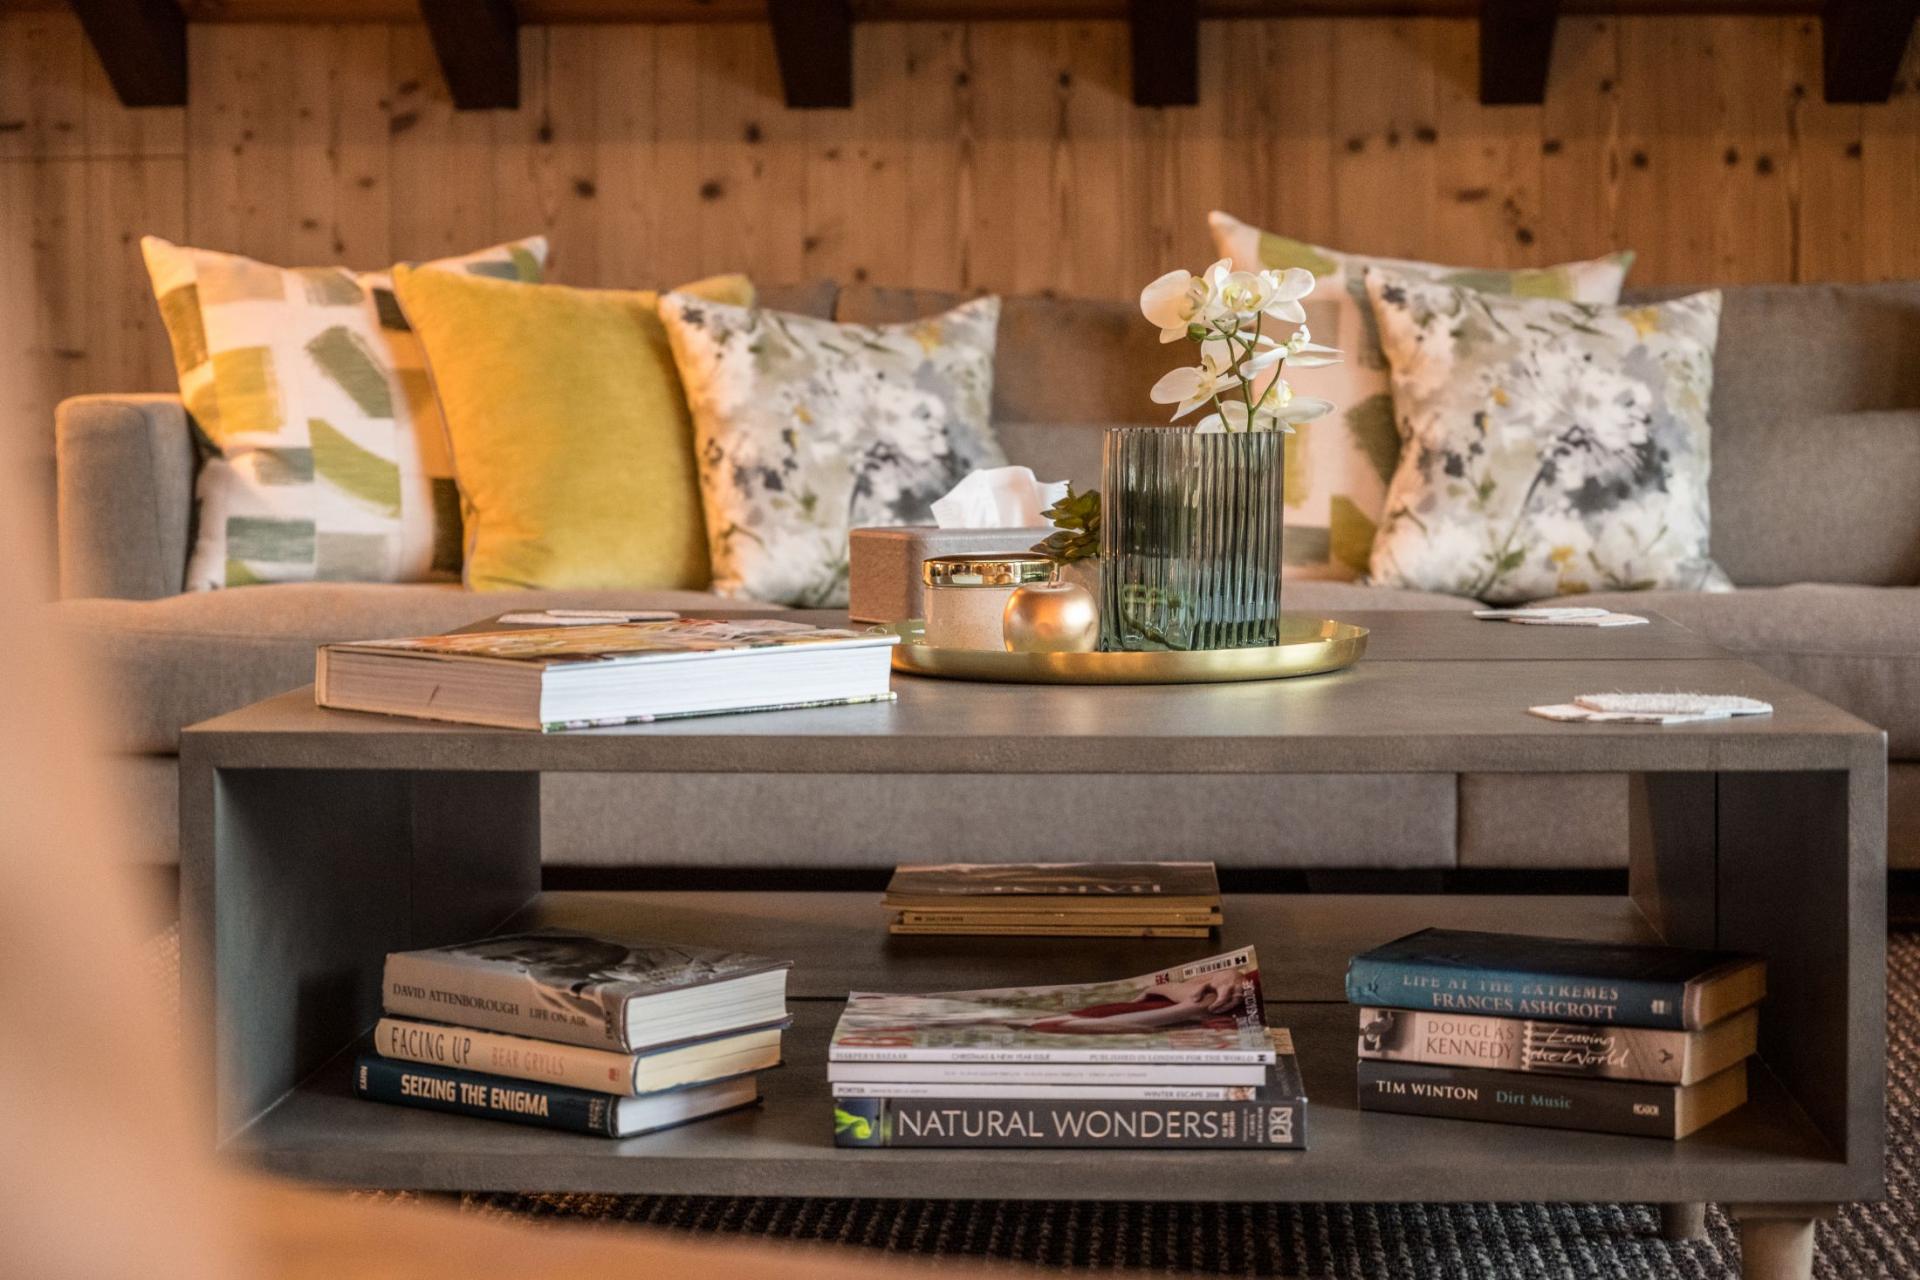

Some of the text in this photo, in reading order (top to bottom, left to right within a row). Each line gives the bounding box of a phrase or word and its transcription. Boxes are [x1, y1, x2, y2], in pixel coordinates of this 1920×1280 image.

[393, 984, 520, 1015] DAVID ATTENBOROUGH
[1403, 974, 1619, 1001] LIFE AT THE EXTREMES
[529, 1007, 589, 1027] LIFE ON AIR
[1432, 992, 1617, 1020] FRANCES ASHCROFT
[1427, 1020, 1515, 1041] DOUGLAS
[1546, 1031, 1616, 1052] Leaving
[391, 1026, 472, 1065] FACING UP
[1426, 1038, 1513, 1060] KENNEDY
[491, 1047, 566, 1077] BEAR GRYLLS
[1555, 1050, 1629, 1069] World
[401, 1074, 549, 1117] SEIZING THE ENIGMA
[1376, 1080, 1479, 1101] TIM WINTON
[1496, 1090, 1572, 1109] Dirt Music
[898, 1110, 1044, 1138] NATURAL
[1051, 1110, 1219, 1138] WONDERS
